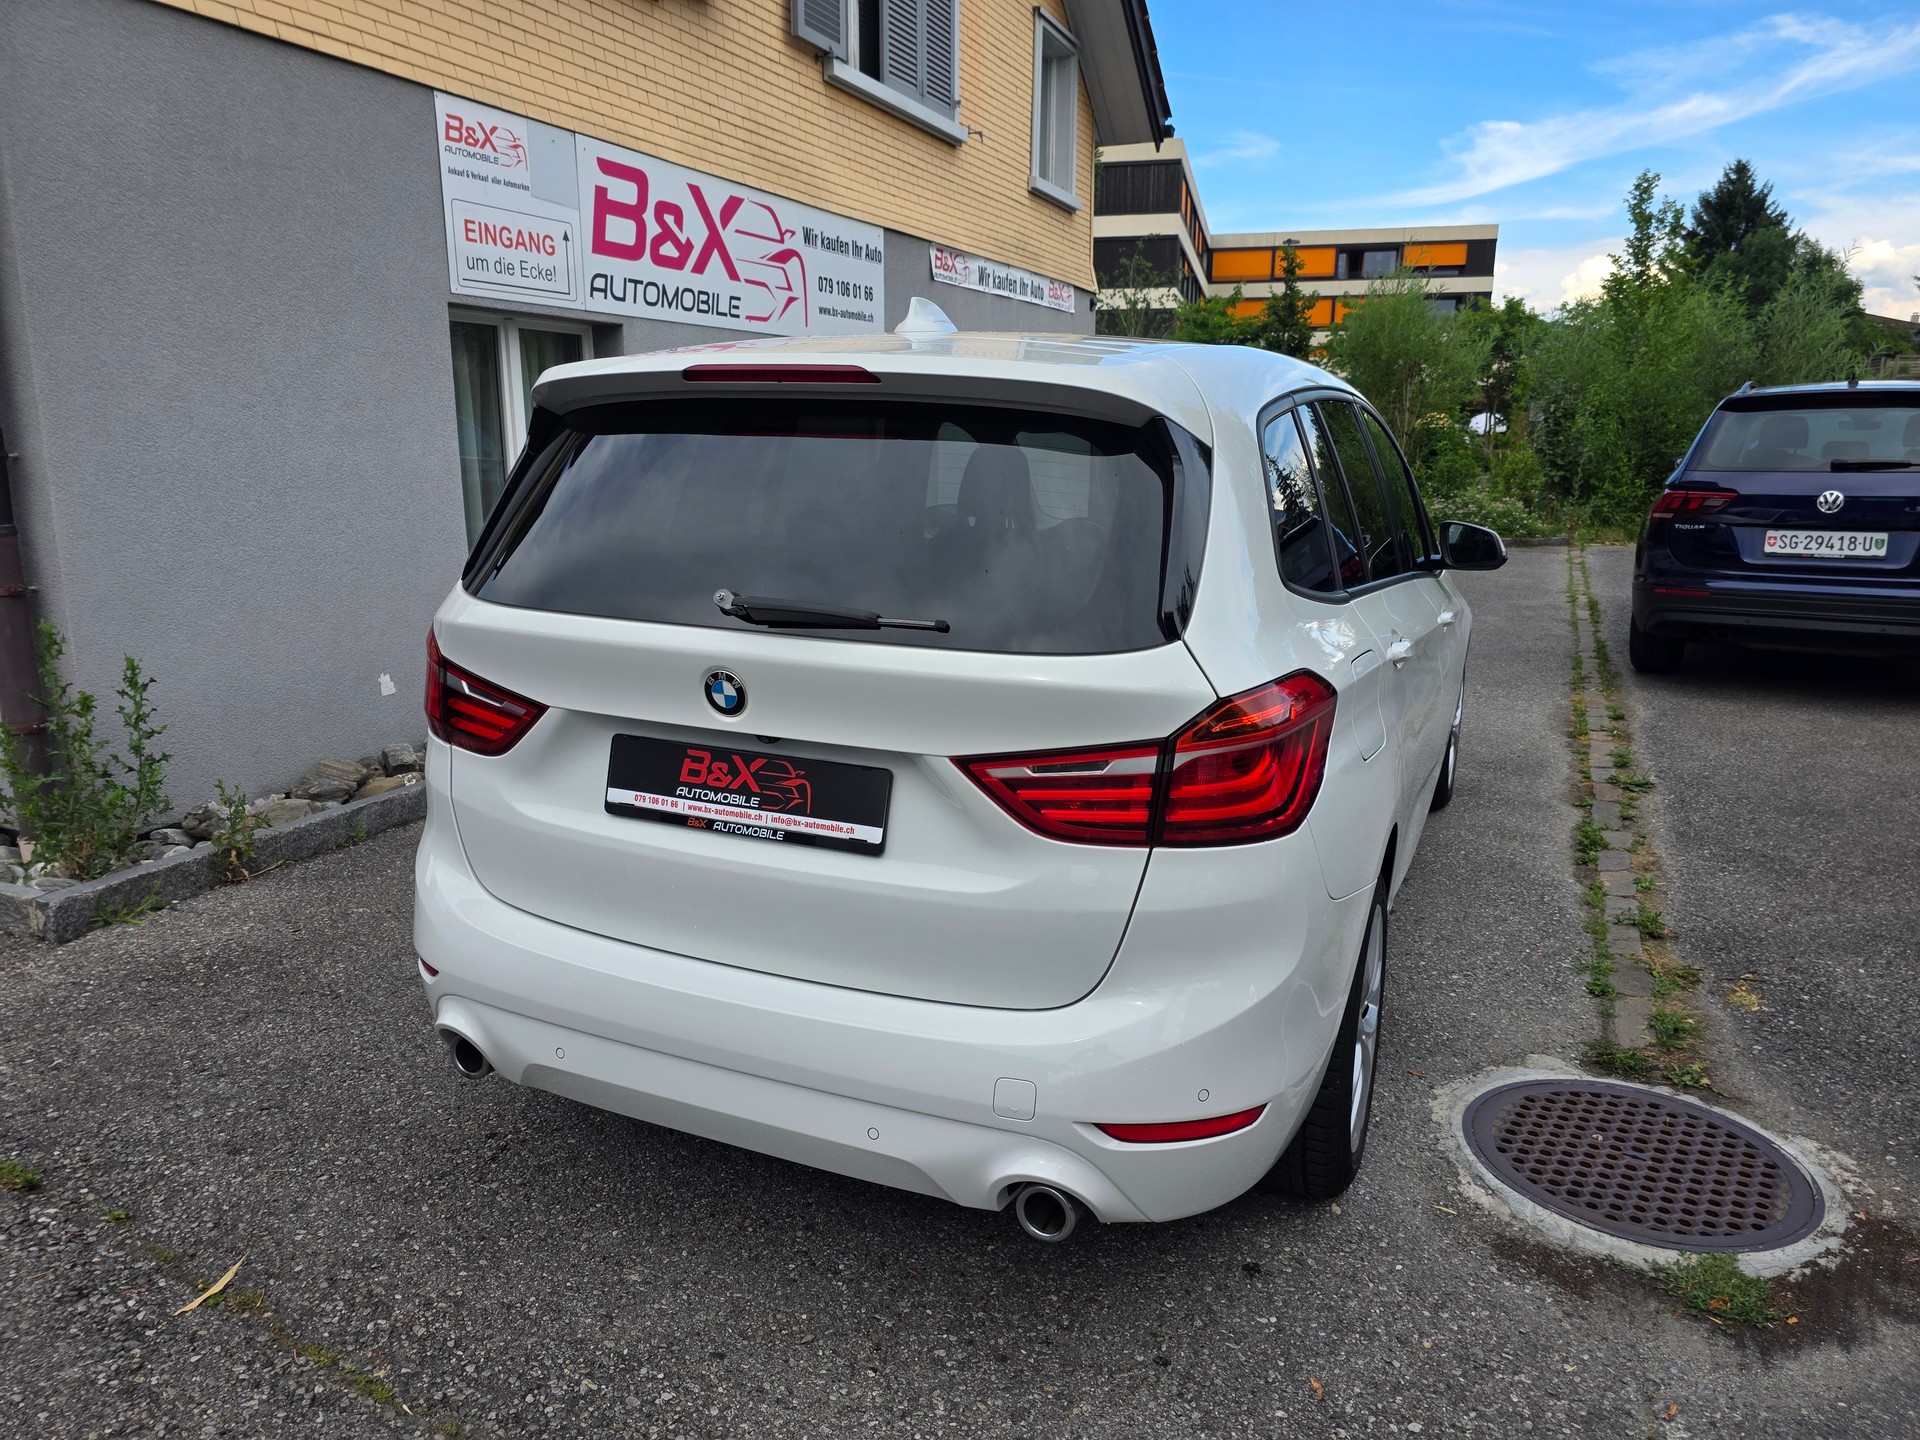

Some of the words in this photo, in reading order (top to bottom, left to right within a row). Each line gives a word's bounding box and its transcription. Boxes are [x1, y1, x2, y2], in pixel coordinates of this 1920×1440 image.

[444, 113, 499, 153] B&X
[444, 145, 499, 165] AUTOMOBILE
[448, 166, 465, 177] Ankauf
[466, 170, 470, 179] &
[470, 171, 489, 183] Verkauf
[491, 177, 502, 185] aller
[503, 179, 530, 191] Automarken
[591, 156, 745, 282] B&X
[463, 218, 556, 256] EINGANG
[802, 226, 818, 247] Wir
[820, 231, 849, 257] kaufen
[852, 240, 862, 258] Ihr
[865, 243, 882, 263] Auto
[466, 255, 489, 273] um
[494, 256, 515, 276] die
[520, 260, 557, 282] Ecke!
[934, 248, 958, 274] B&X
[590, 273, 741, 319] AUTOMOBILE
[818, 275, 833, 294] 079
[836, 280, 850, 297] 106
[852, 283, 861, 300] 01
[864, 285, 873, 302] 66
[978, 265, 990, 288] Wir
[992, 273, 1017, 295] kaufen
[1019, 276, 1029, 296] Ihr
[1030, 280, 1045, 301] Auto
[818, 306, 874, 323] www.bx-automobile.ch
[706, 672, 741, 689] BMW
[679, 749, 768, 793] B&X
[676, 786, 760, 808] AUTOMOBILE
[634, 794, 647, 803] 079
[648, 796, 660, 805] 106
[660, 798, 670, 806] 01
[670, 799, 679, 809] 66
[687, 803, 763, 822] www.bx-automobile.ch
[770, 815, 855, 835] info@bx-automobile.ch
[687, 817, 708, 829] B&X
[713, 821, 785, 841] AUTOMOBILE
